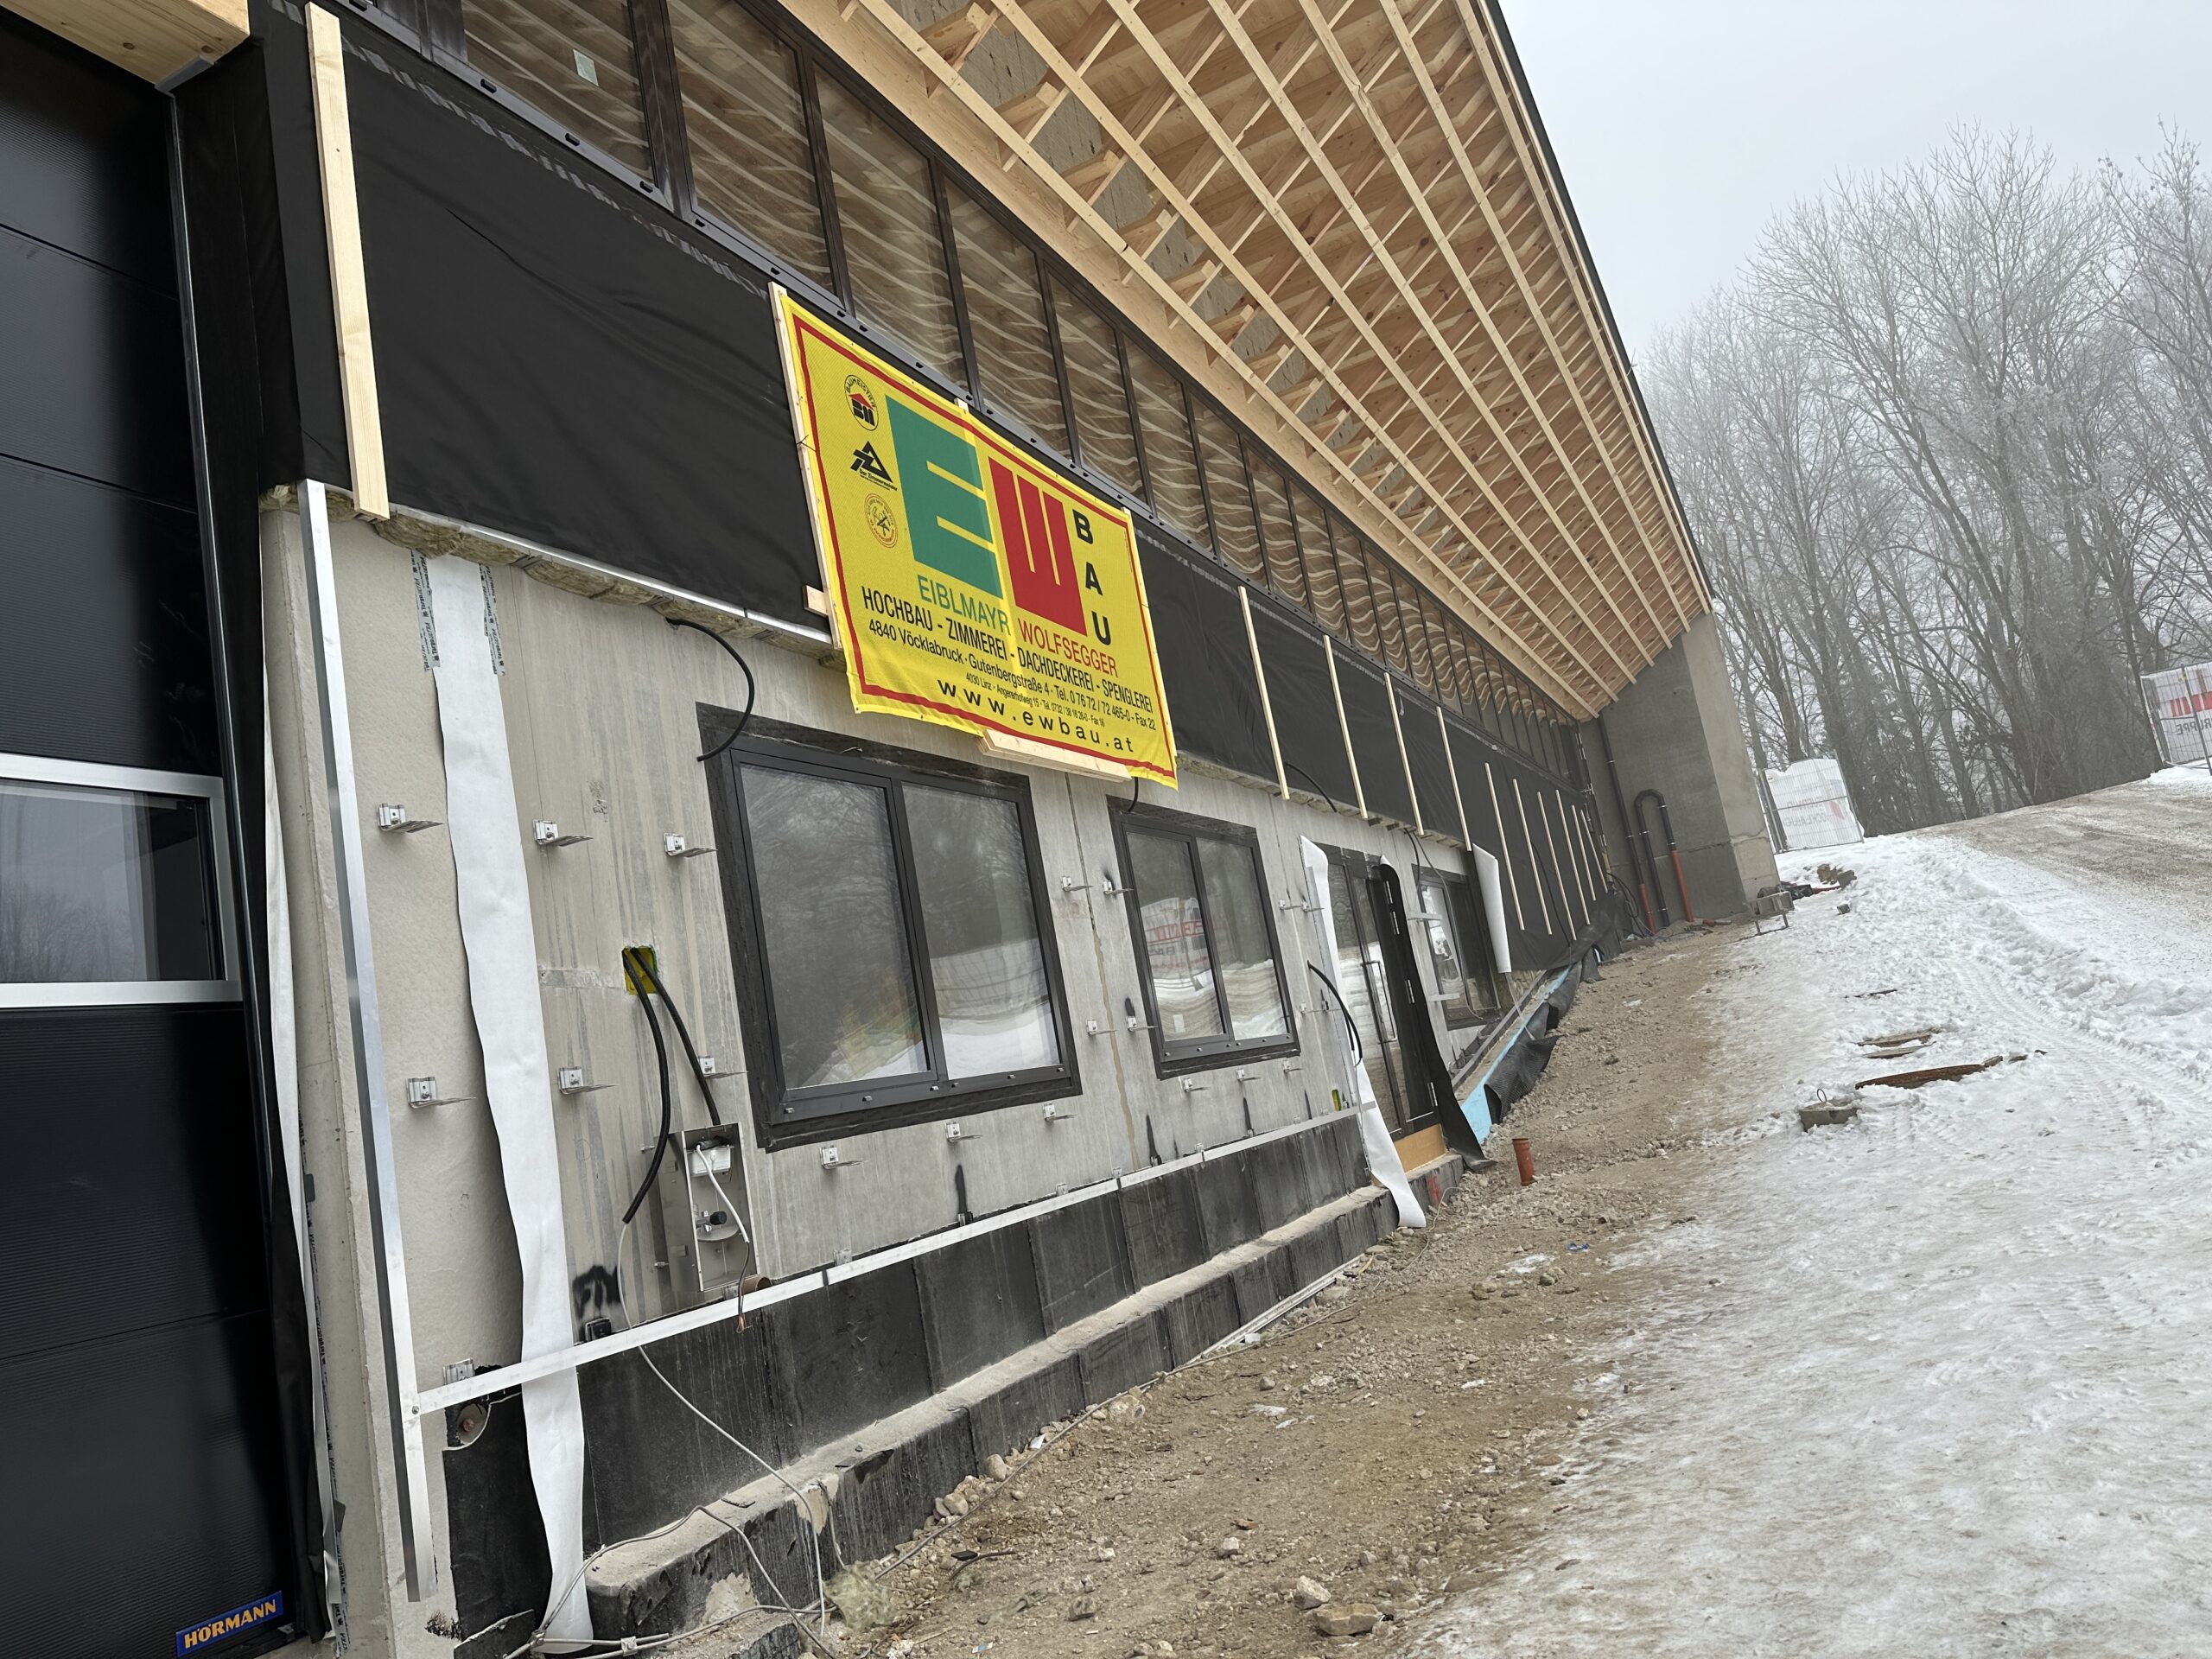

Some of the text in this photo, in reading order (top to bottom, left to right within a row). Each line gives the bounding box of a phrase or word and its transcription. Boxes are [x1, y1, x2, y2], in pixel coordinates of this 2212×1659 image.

[917, 575, 1011, 635] EIBLMAYR
[861, 586, 933, 631] HOCHBAU
[945, 617, 1007, 661] ZIMMEREI
[1017, 646, 1094, 691] DACHDECKEREI
[1102, 678, 1153, 714] SPENGLEREI
[869, 619, 896, 641] 4840
[898, 627, 964, 664] Vöcklabruck
[969, 653, 1042, 693] Gutenbergstraße
[1044, 683, 1050, 695] 4
[1054, 684, 1069, 702] Tel.
[1076, 692, 1086, 707] 76
[1087, 696, 1096, 710] 72
[1102, 701, 1111, 715] 72
[1112, 704, 1130, 721] 465-0
[1135, 713, 1147, 728] Fax
[1147, 718, 1156, 731] 22
[1018, 618, 1118, 677] WOLFSEGGER
[966, 672, 980, 685] 4030
[980, 678, 993, 690] Linz
[938, 680, 1134, 753] www.ewbau.at
[184, 1599, 276, 1649] HÖRMANN
